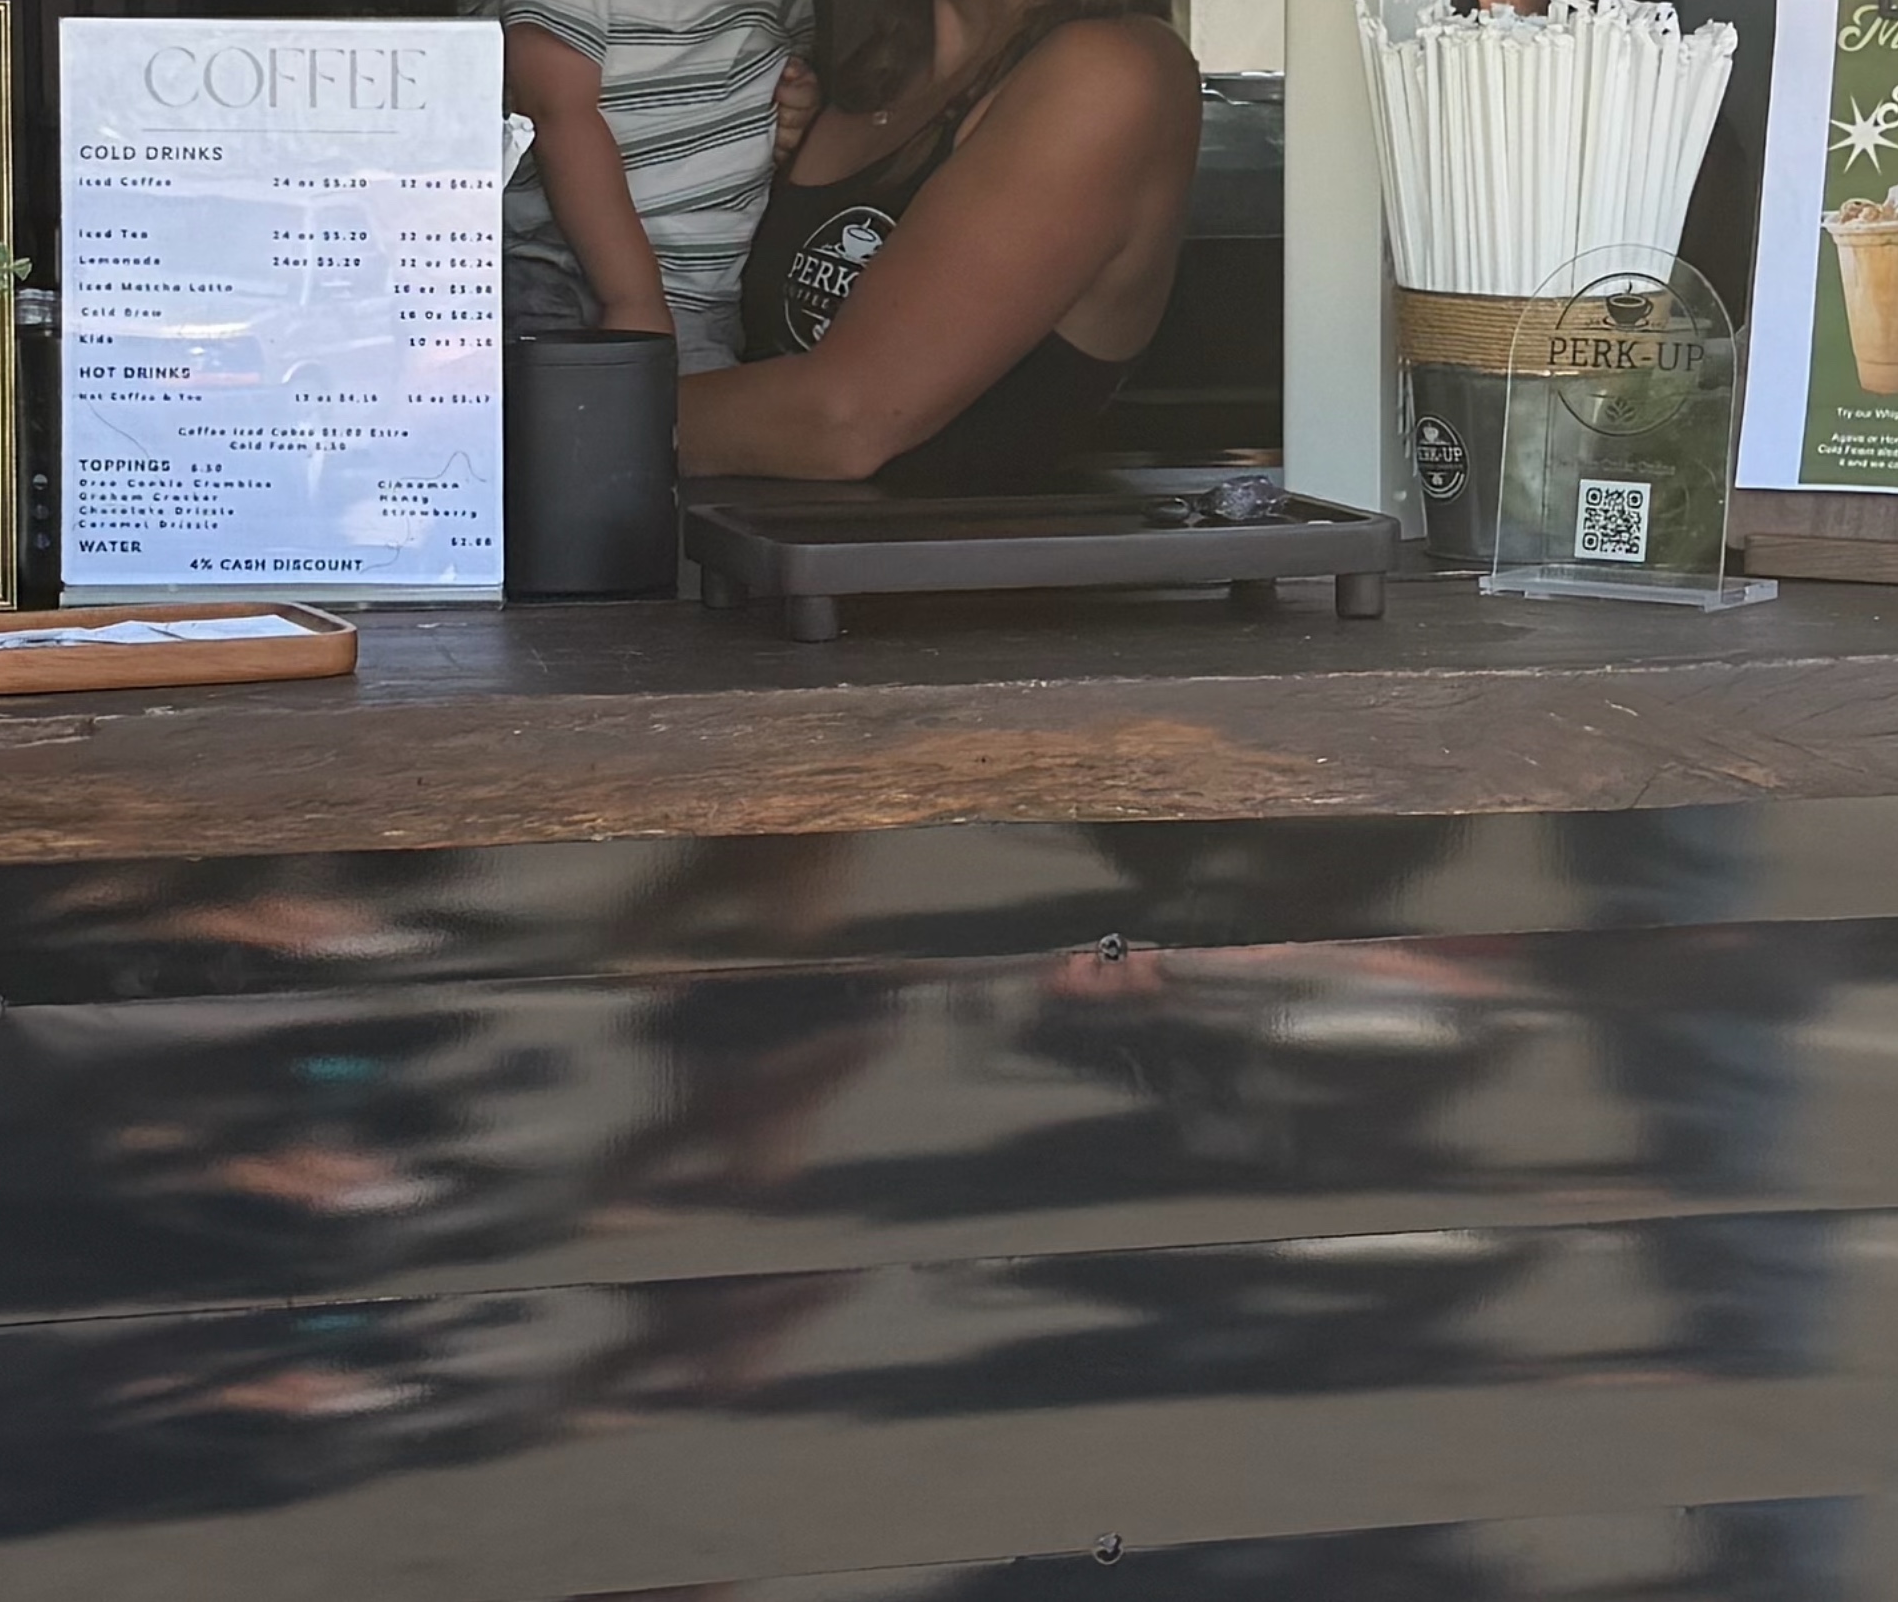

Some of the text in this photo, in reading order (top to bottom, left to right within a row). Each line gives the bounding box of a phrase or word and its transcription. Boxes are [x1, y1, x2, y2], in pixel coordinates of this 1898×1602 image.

[144, 46, 426, 109] COFFEE
[80, 145, 223, 160] COLD DRINKS
[121, 177, 171, 186] Coffee
[79, 255, 160, 265] Lemonade
[122, 282, 180, 292] Matcha
[79, 334, 113, 344] Kids
[1547, 337, 1705, 372] PERK-UP
[79, 367, 191, 379] HOT DRINKS
[229, 441, 262, 450] Cold
[79, 459, 171, 473] TOPPINGS
[378, 481, 459, 489] Cinnamon
[79, 540, 142, 553] WATER
[190, 559, 363, 571] 4% CASH DISCOUNT
